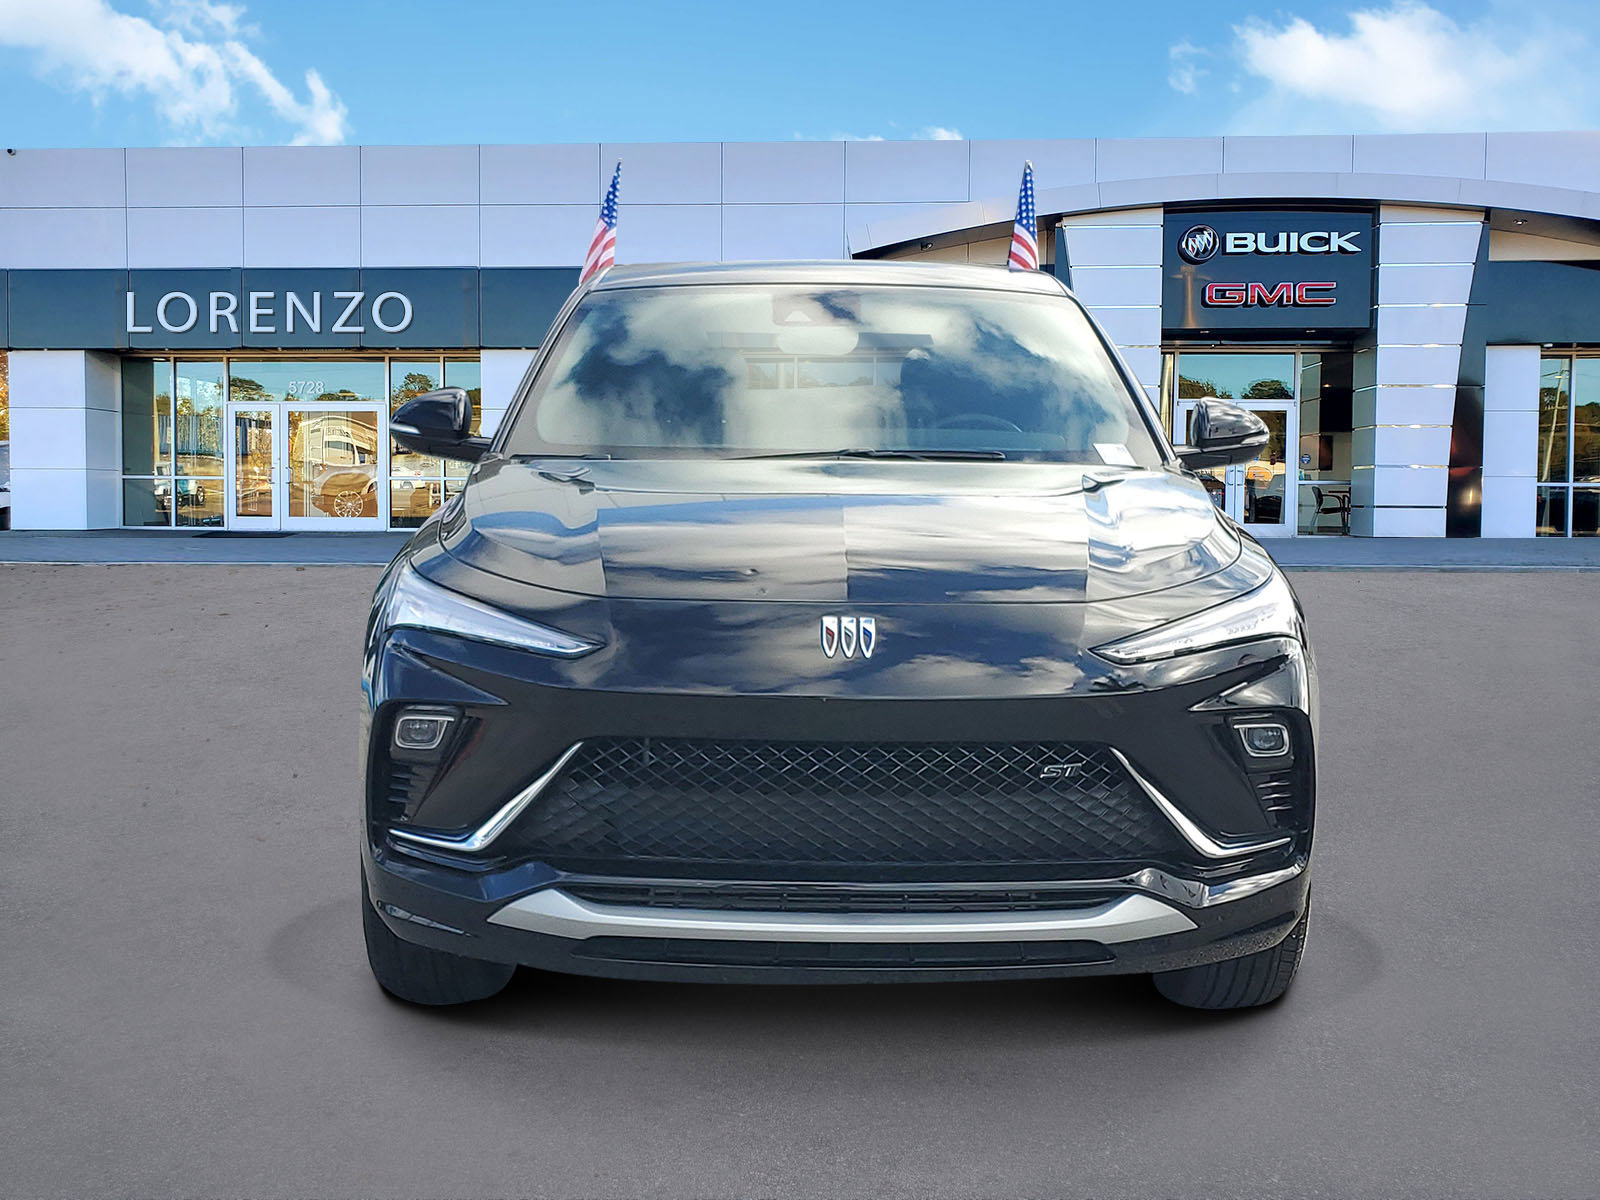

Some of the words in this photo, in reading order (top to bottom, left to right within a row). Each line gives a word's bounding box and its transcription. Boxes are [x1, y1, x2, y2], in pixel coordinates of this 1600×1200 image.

[1225, 231, 1362, 254] BUICK
[1204, 282, 1337, 306] GMC
[125, 290, 413, 334] LORENZO
[288, 380, 325, 394] 5728
[1040, 762, 1083, 779] ST
